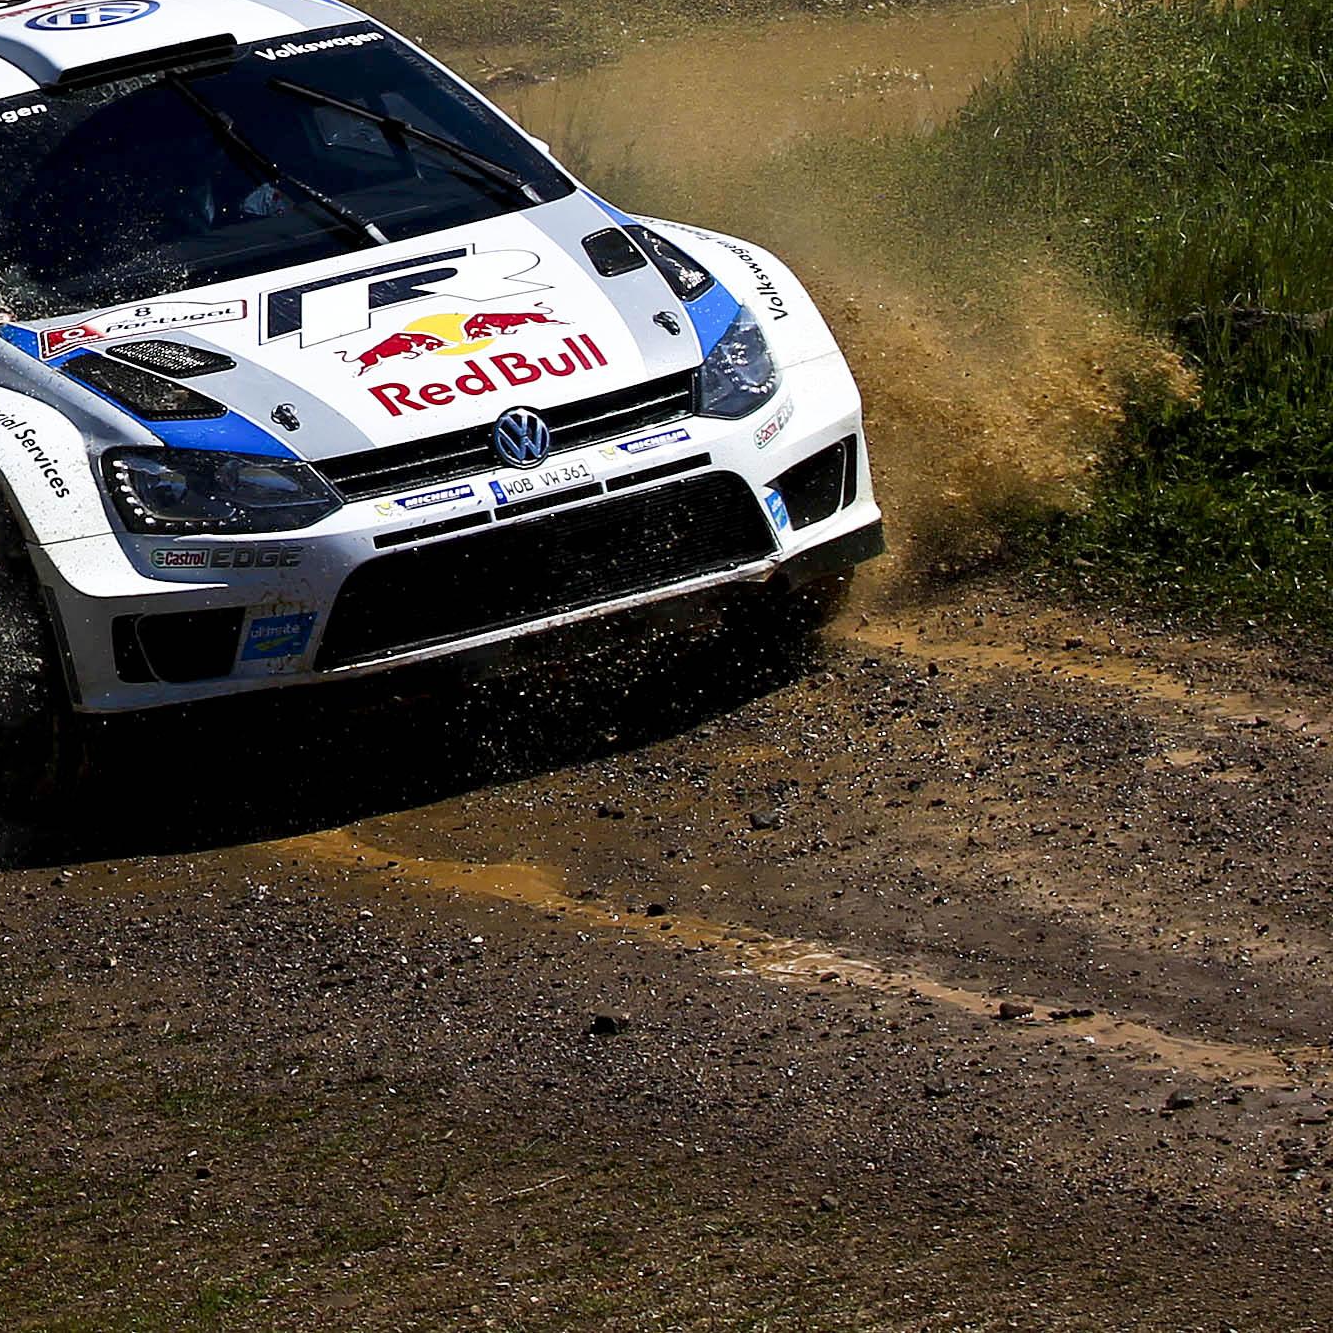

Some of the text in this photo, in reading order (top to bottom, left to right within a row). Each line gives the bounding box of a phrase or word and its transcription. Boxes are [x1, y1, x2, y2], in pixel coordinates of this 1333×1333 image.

[254, 31, 385, 62] Volkswagen
[716, 240, 789, 321] Volkswagen
[105, 308, 237, 334] Portugal
[134, 306, 151, 317] 8
[367, 333, 608, 417] Red Bull
[626, 429, 687, 452] MICHELIN
[14, 427, 70, 499] Services
[503, 478, 534, 496] WOB
[539, 471, 561, 487] VW
[560, 464, 591, 482] 361
[404, 484, 472, 507] MICHELIN
[164, 546, 304, 568] Castrol EDGE
